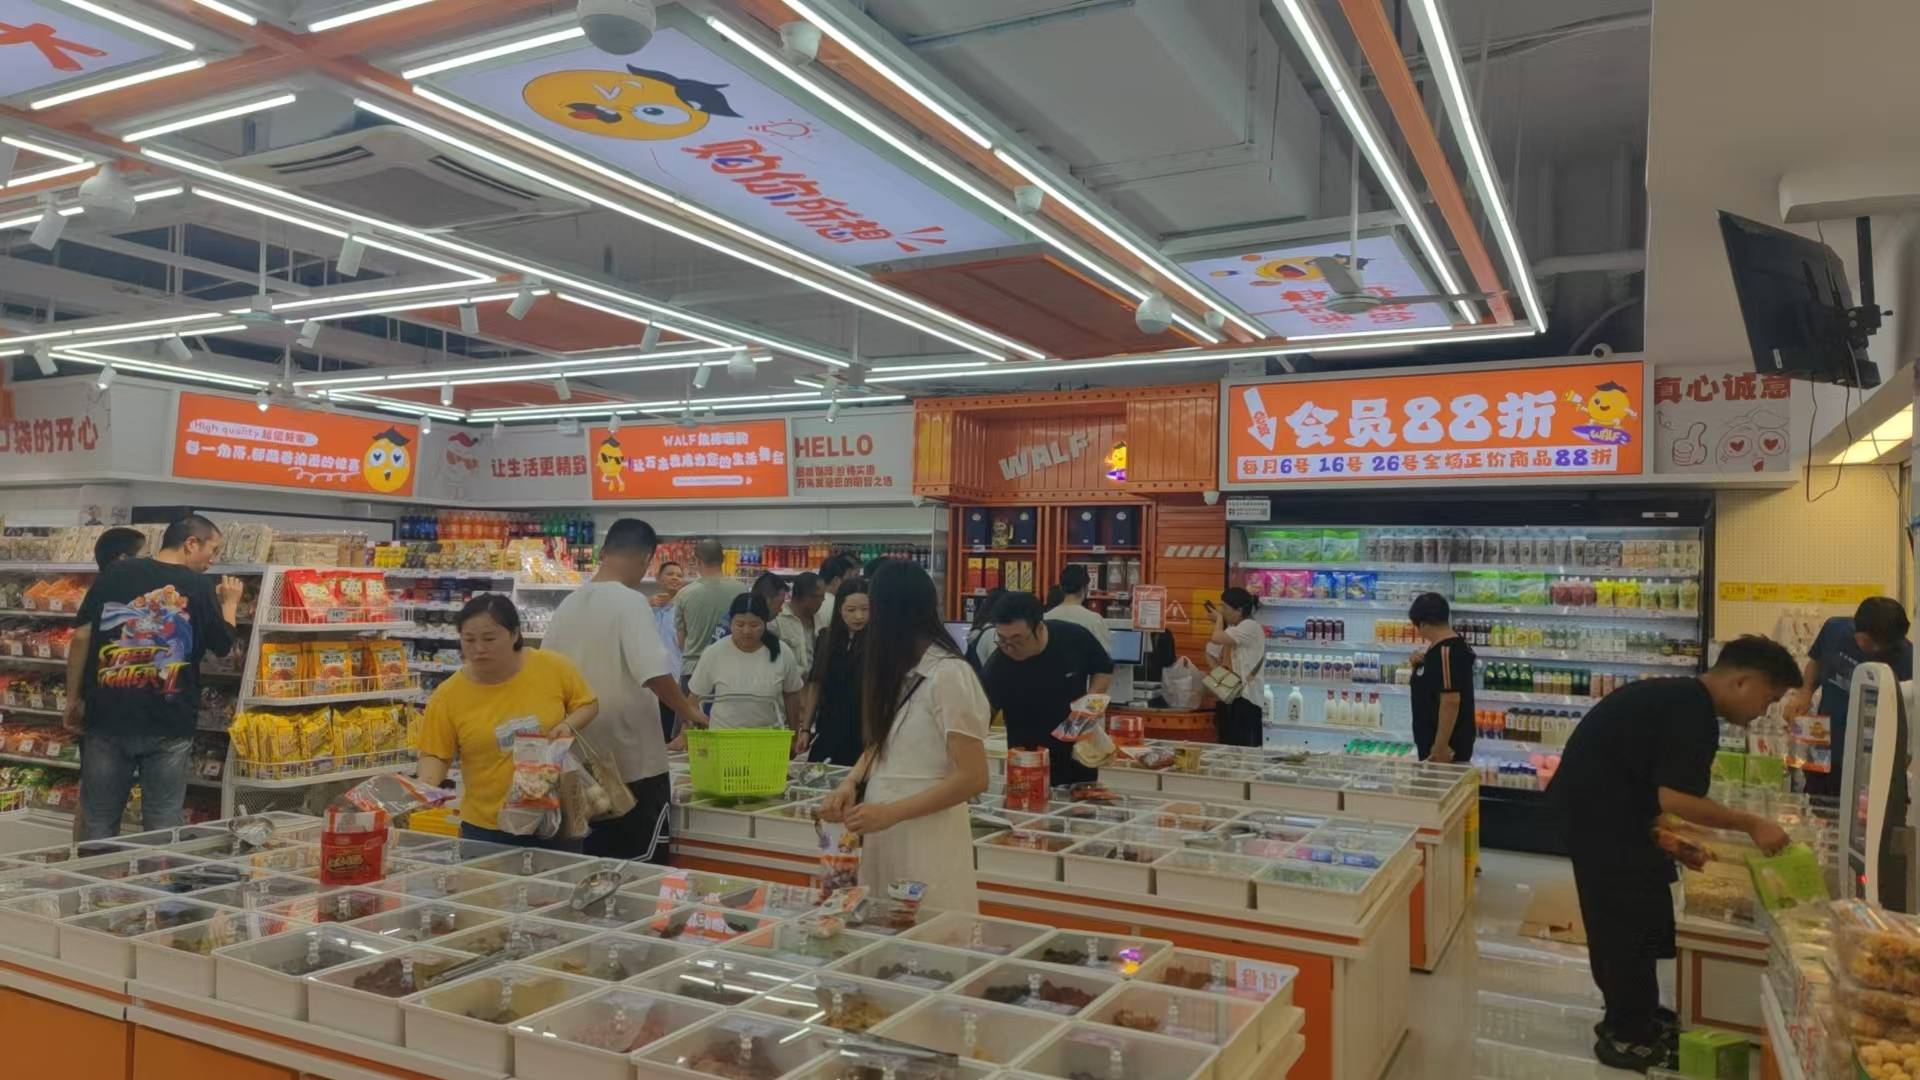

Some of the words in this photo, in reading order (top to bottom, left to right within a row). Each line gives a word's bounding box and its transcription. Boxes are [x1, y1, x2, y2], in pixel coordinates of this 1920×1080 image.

[679, 138, 896, 245] 购你所想
[1285, 390, 1558, 448] 会员88折
[794, 433, 873, 458] HELLO
[999, 431, 1089, 481] WALF
[1242, 456, 1310, 475] 每月6号
[1318, 456, 1363, 473] 16号
[1372, 448, 1613, 472] 26号全场正价商品88折
[491, 455, 587, 478] 让生活更精致
